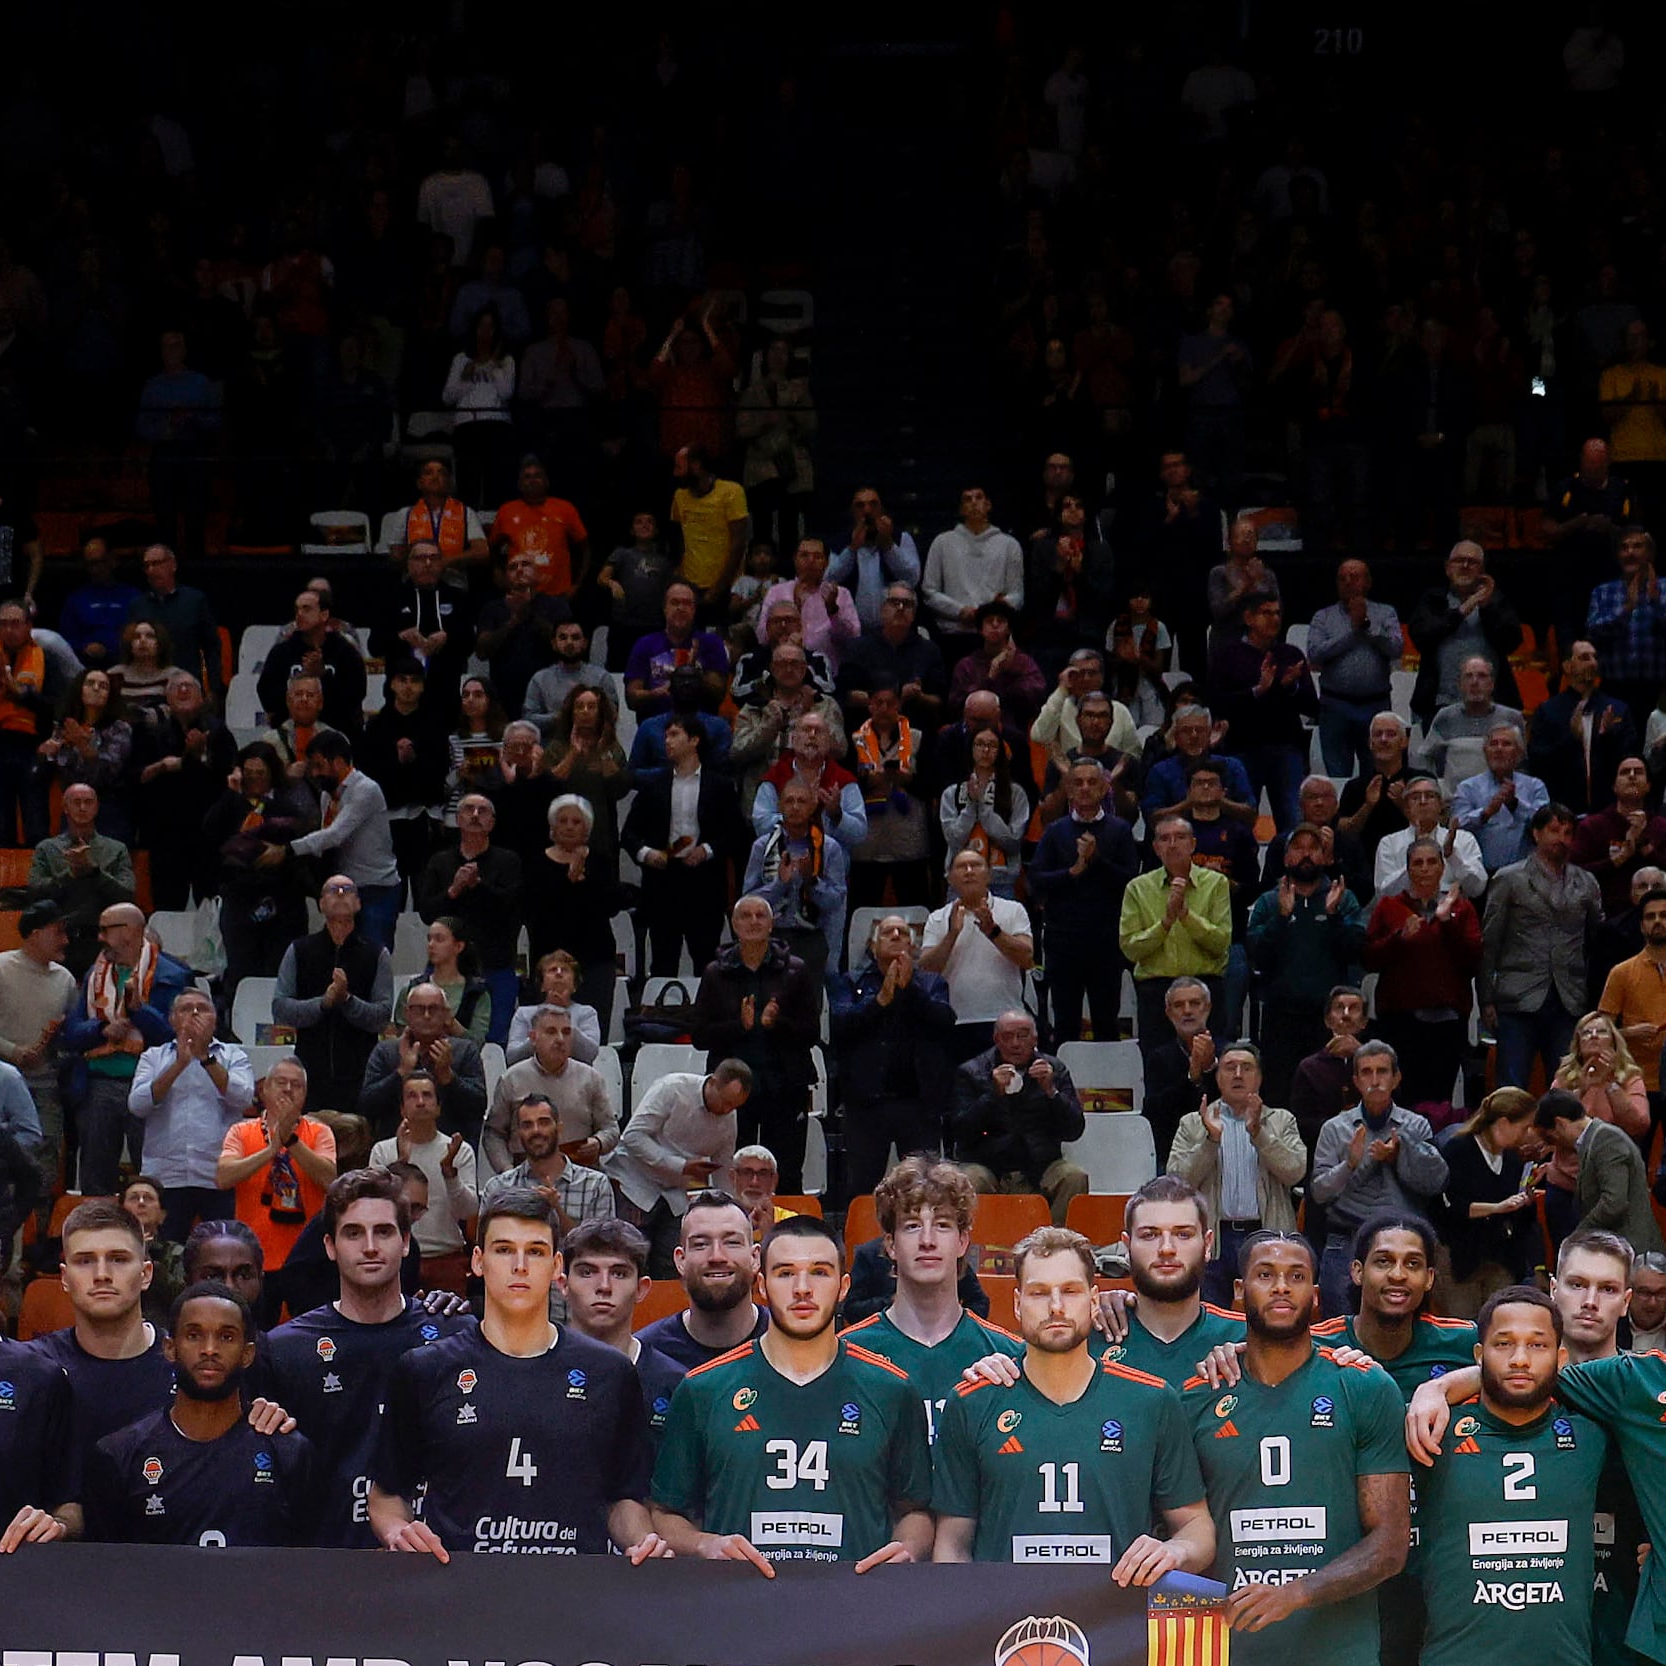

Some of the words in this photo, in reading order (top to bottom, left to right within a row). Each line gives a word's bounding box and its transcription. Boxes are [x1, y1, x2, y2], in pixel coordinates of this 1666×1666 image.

[1312, 27, 1363, 56] 210
[506, 1437, 537, 1486] 4
[766, 1440, 829, 1490] 34
[1261, 1437, 1290, 1485] 0
[1039, 1463, 1083, 1512] 11
[1503, 1453, 1536, 1499] 2
[475, 1516, 559, 1540] Cultura
[560, 1528, 577, 1540] del
[762, 1522, 832, 1536] PETROL
[1241, 1518, 1315, 1531] PETROL
[1482, 1531, 1559, 1544] PETROL
[793, 1551, 804, 1559] za
[1025, 1546, 1100, 1557] PETROL
[1235, 1547, 1268, 1558] Energija
[1270, 1548, 1281, 1556] za
[1472, 1560, 1513, 1571] Energija
[1473, 1580, 1564, 1610] ARGETA
